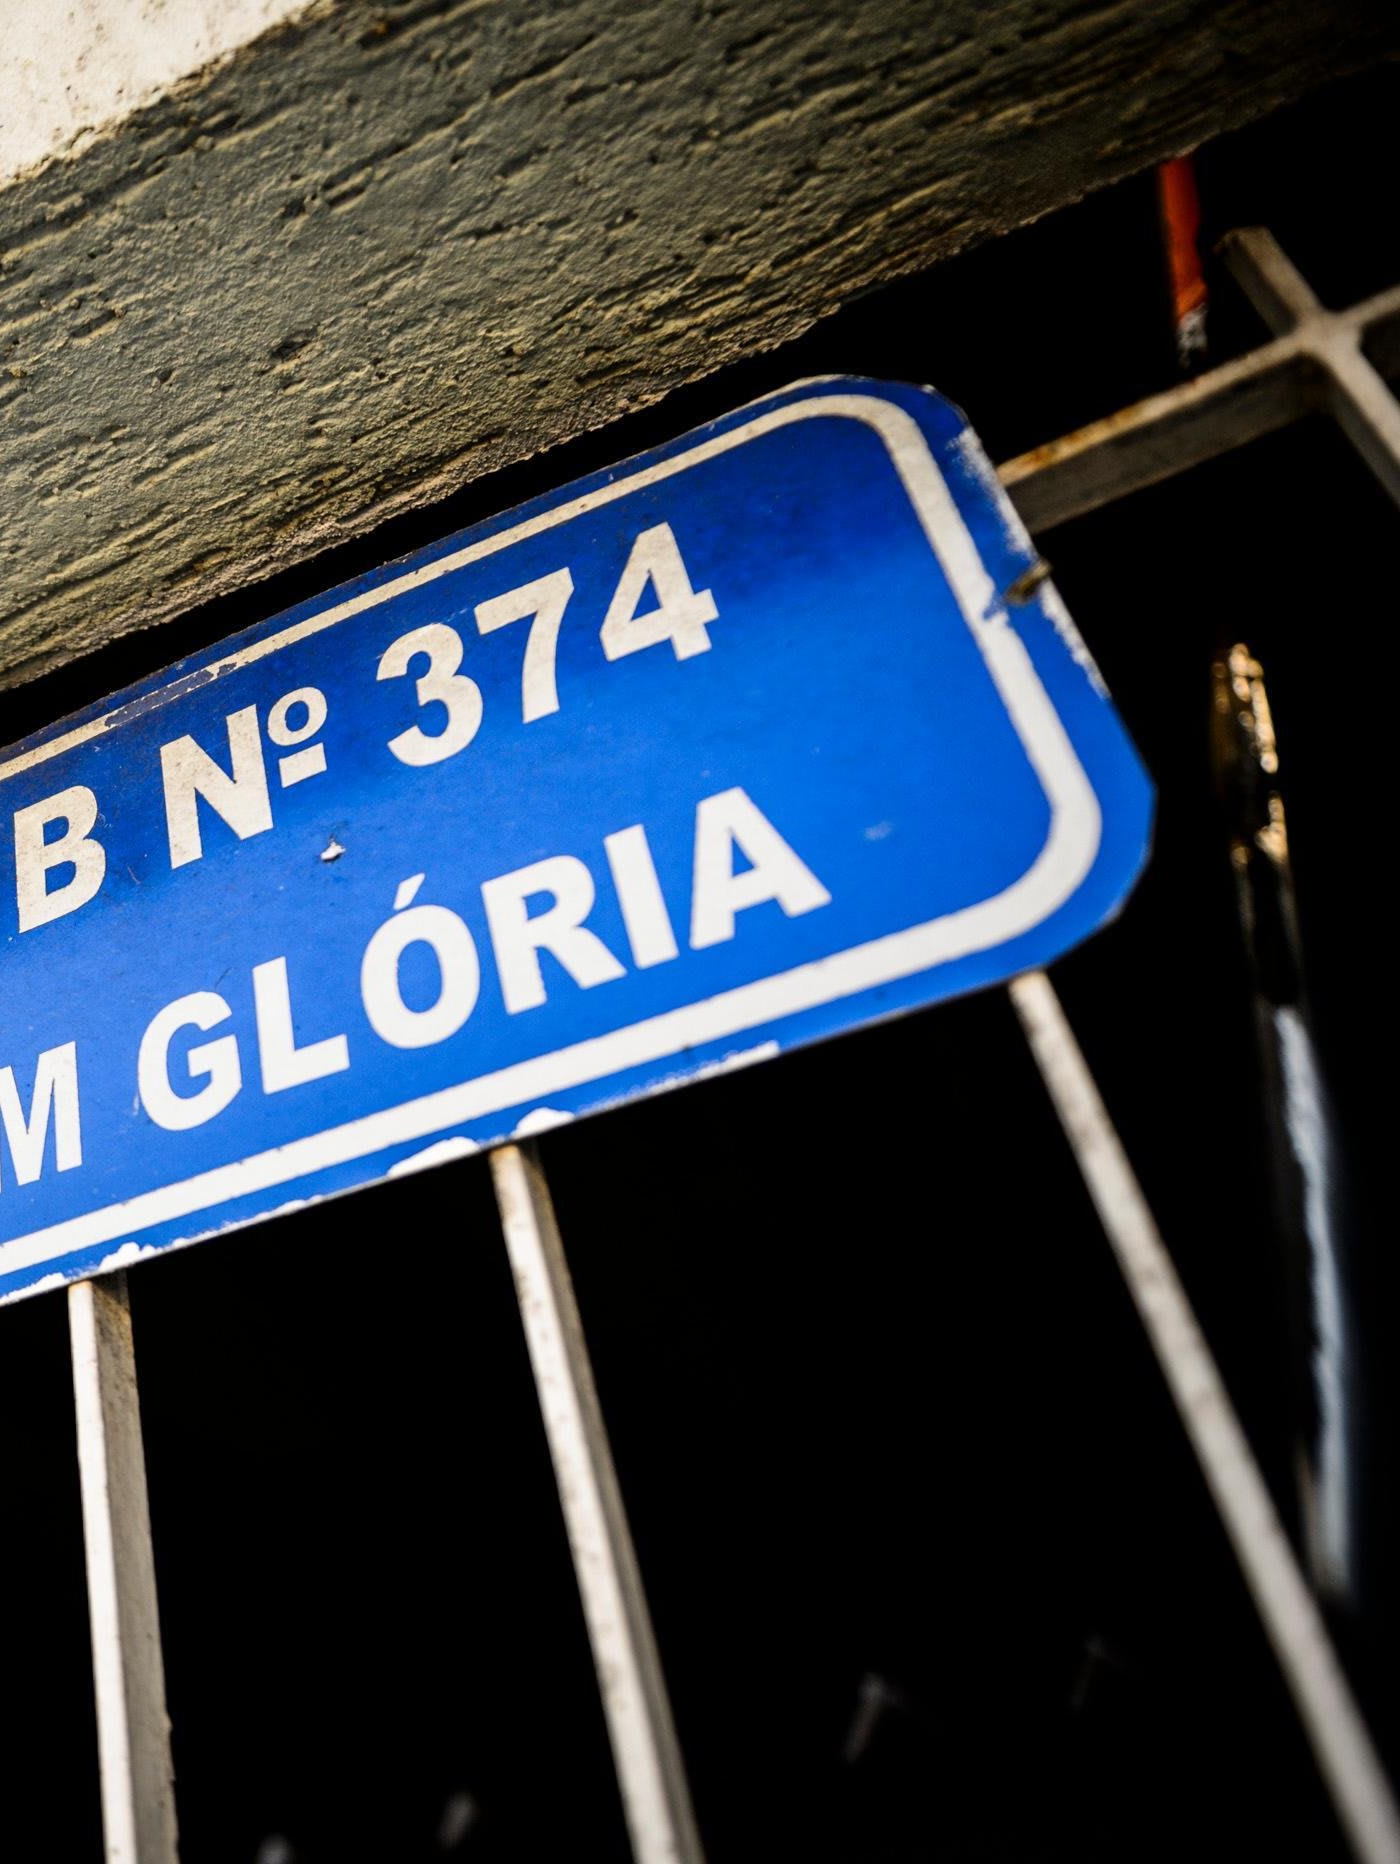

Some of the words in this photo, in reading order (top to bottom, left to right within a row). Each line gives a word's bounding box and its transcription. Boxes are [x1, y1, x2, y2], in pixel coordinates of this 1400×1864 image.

[12, 784, 108, 935] B
[374, 521, 719, 767] 374
[132, 786, 831, 1132] GLÓRIA
